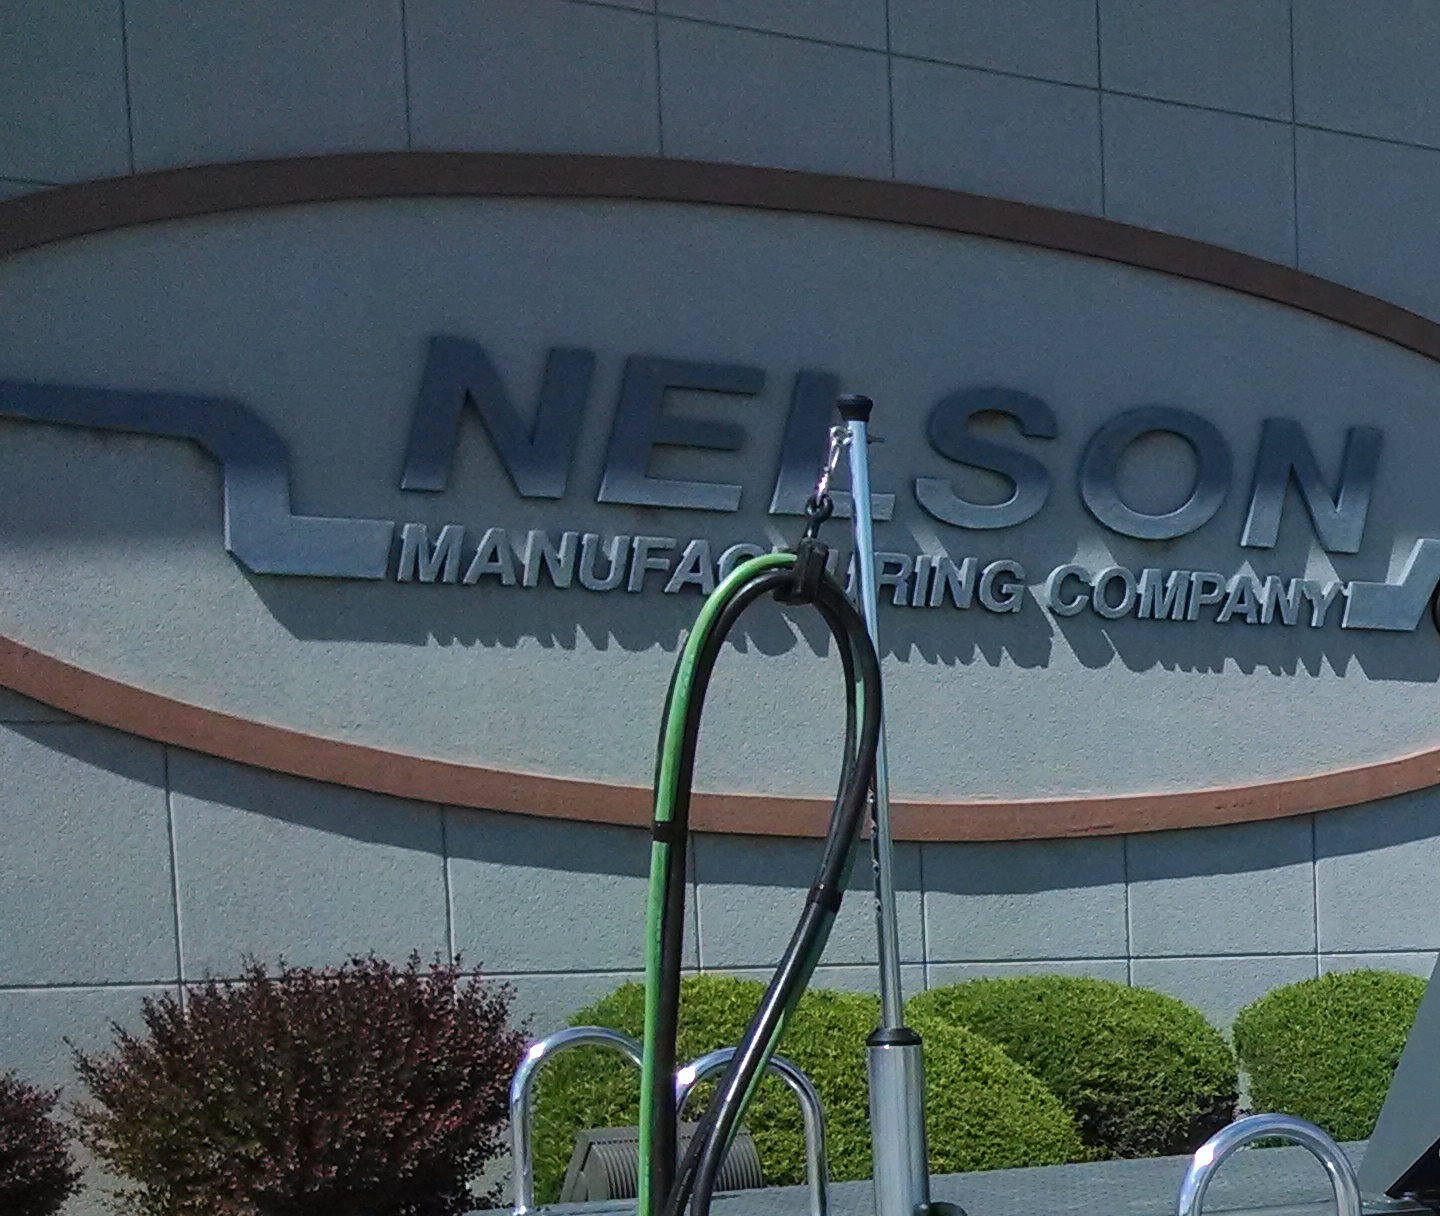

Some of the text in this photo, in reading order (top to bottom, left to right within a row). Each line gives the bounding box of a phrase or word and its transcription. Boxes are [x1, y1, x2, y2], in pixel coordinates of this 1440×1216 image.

[400, 335, 1384, 553] NELSON
[397, 522, 1345, 628] MANUFACRING COMPANY
